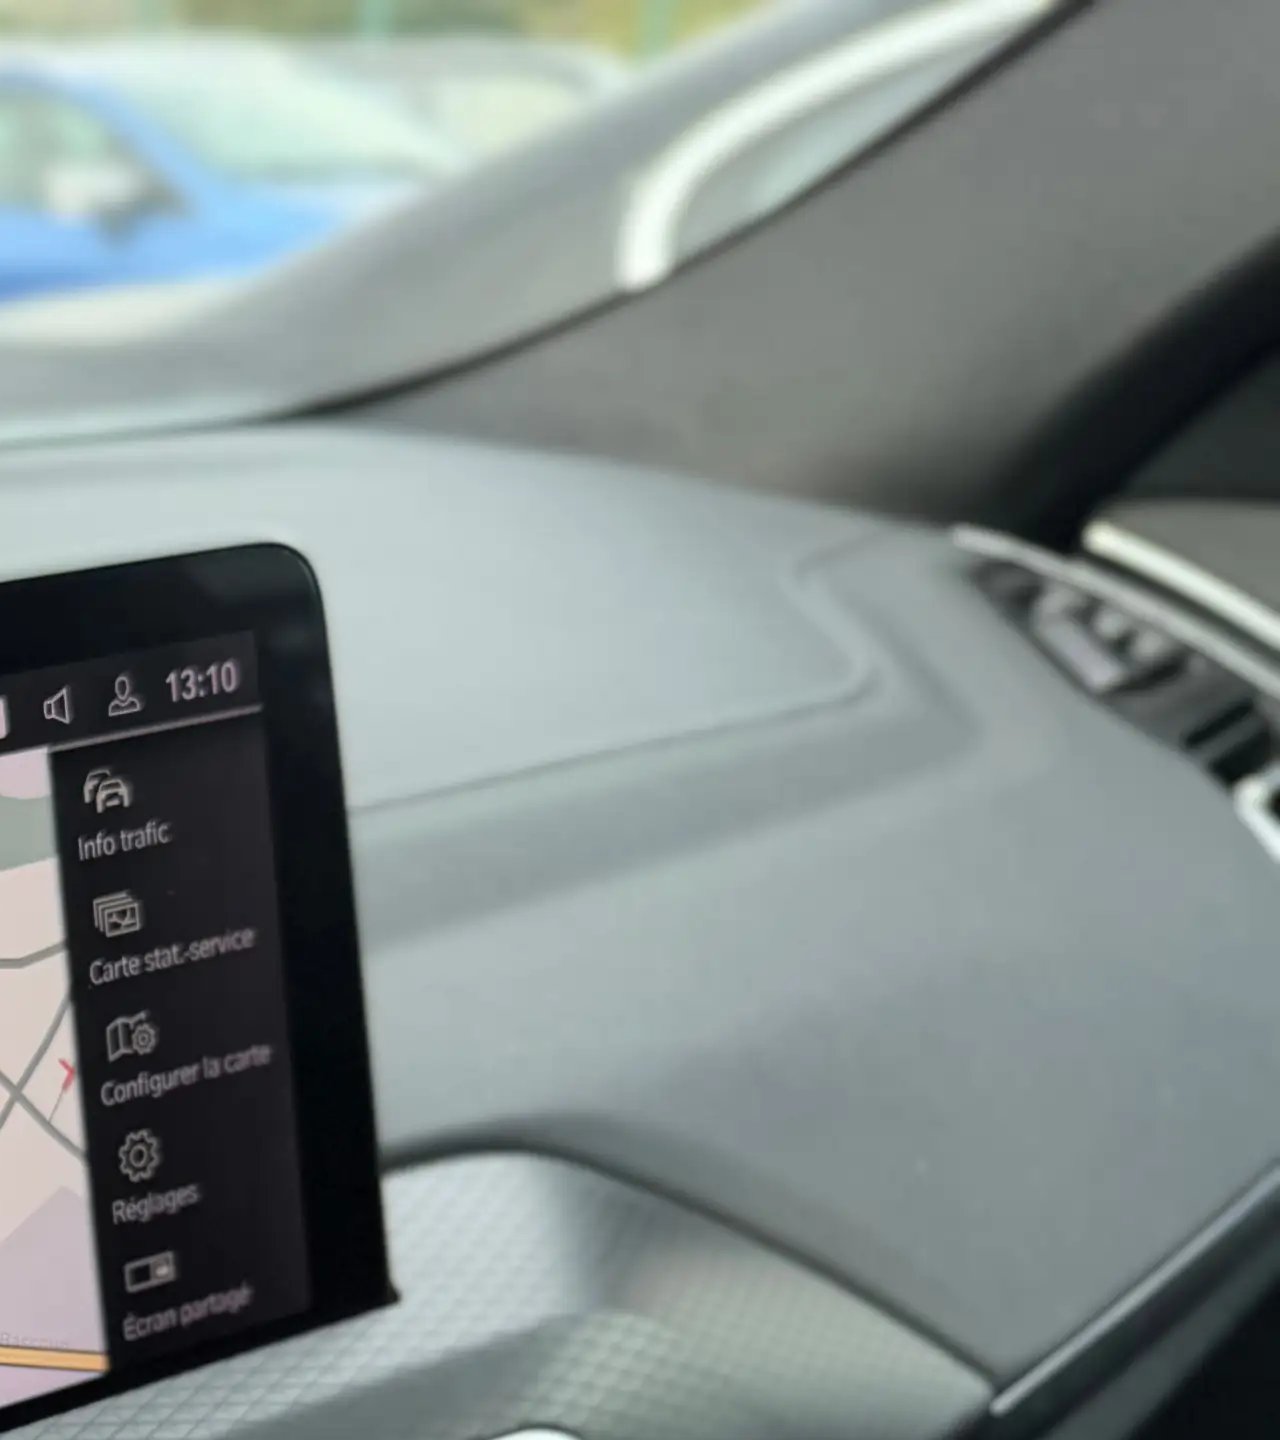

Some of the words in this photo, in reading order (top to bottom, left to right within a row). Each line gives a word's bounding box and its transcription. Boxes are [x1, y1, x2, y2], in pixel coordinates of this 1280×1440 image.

[166, 660, 239, 703] 13:10
[78, 830, 117, 861] Info
[121, 820, 172, 855] trafic
[89, 955, 142, 986] Carte
[100, 1063, 200, 1106] Configurer
[203, 1056, 220, 1081] la
[223, 1044, 272, 1072] carte
[112, 1183, 200, 1225] Réglages
[180, 1283, 254, 1328] partagé
